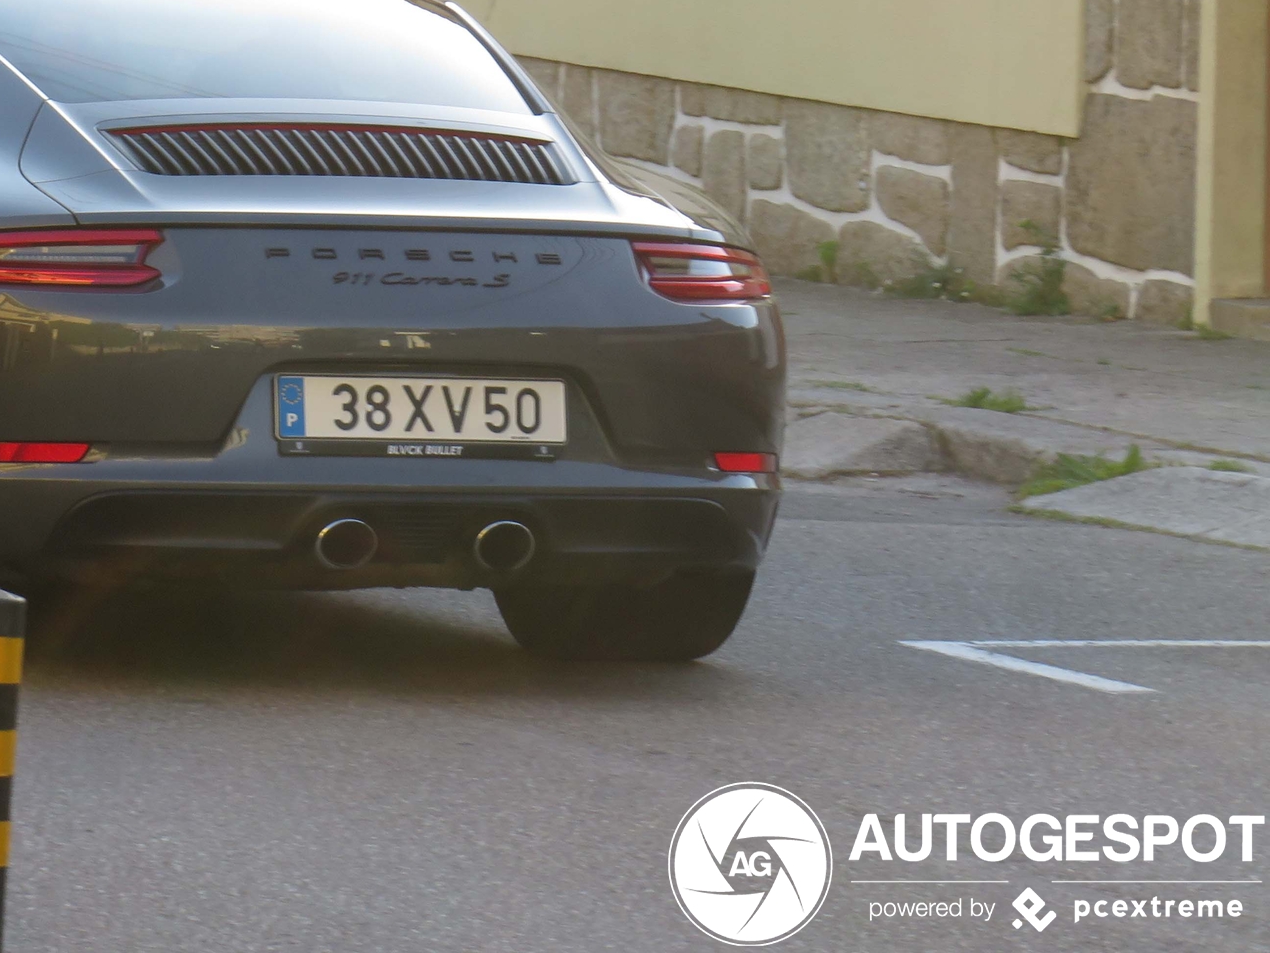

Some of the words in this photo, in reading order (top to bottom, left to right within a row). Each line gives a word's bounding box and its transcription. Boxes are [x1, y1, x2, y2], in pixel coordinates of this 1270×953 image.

[265, 248, 562, 265] PORSCHE
[333, 271, 376, 286] 911
[381, 272, 479, 286] Carrera
[482, 273, 510, 288] S
[286, 413, 298, 427] P
[425, 445, 464, 456] BULLET
